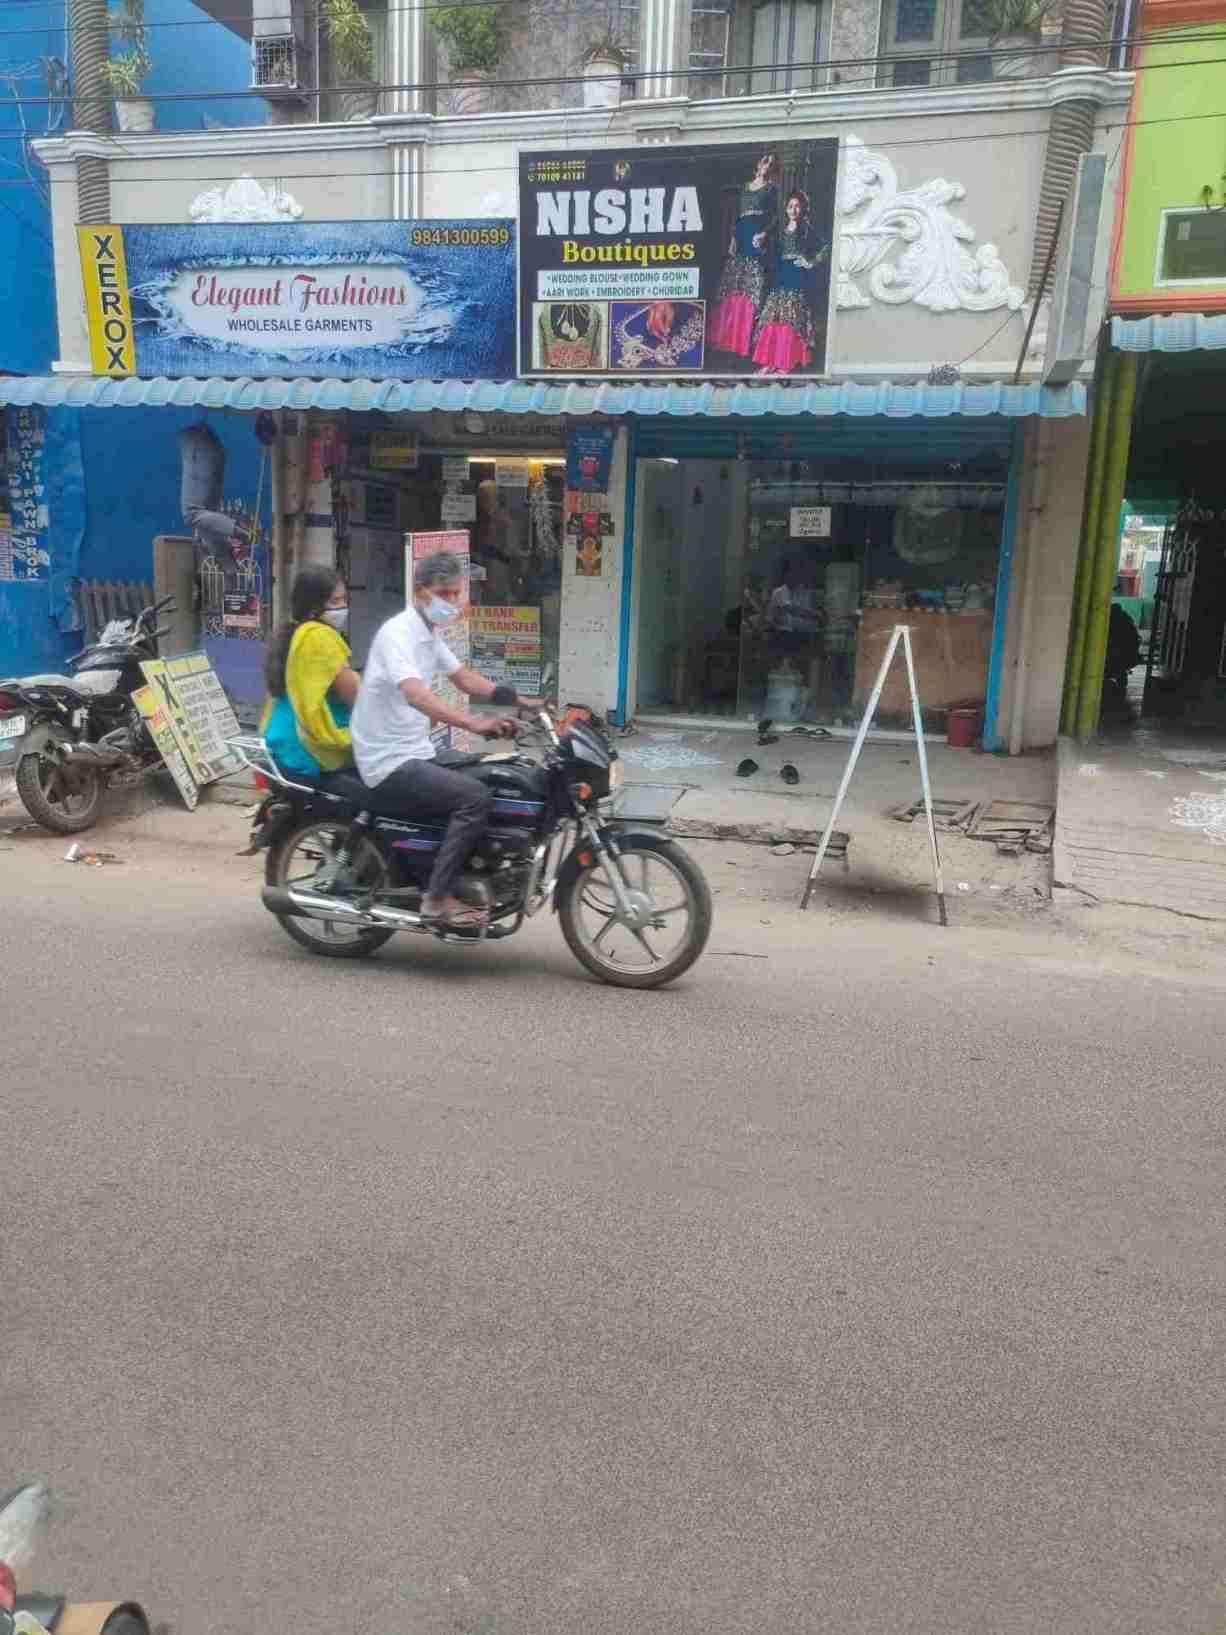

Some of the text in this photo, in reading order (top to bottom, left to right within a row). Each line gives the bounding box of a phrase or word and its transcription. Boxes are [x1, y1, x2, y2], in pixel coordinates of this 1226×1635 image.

[536, 186, 703, 236] NISHA
[412, 228, 509, 245] 9841300599
[562, 238, 695, 267] Boutiques
[661, 271, 689, 282] GOWN
[94, 234, 127, 370] XEROX
[191, 273, 408, 313] Elegant Fashions
[567, 287, 590, 297] WORK
[596, 286, 646, 297] EMBROIDERY
[651, 285, 694, 296] CHURIDAR
[227, 317, 373, 333] WHOLESALE GARMENTS
